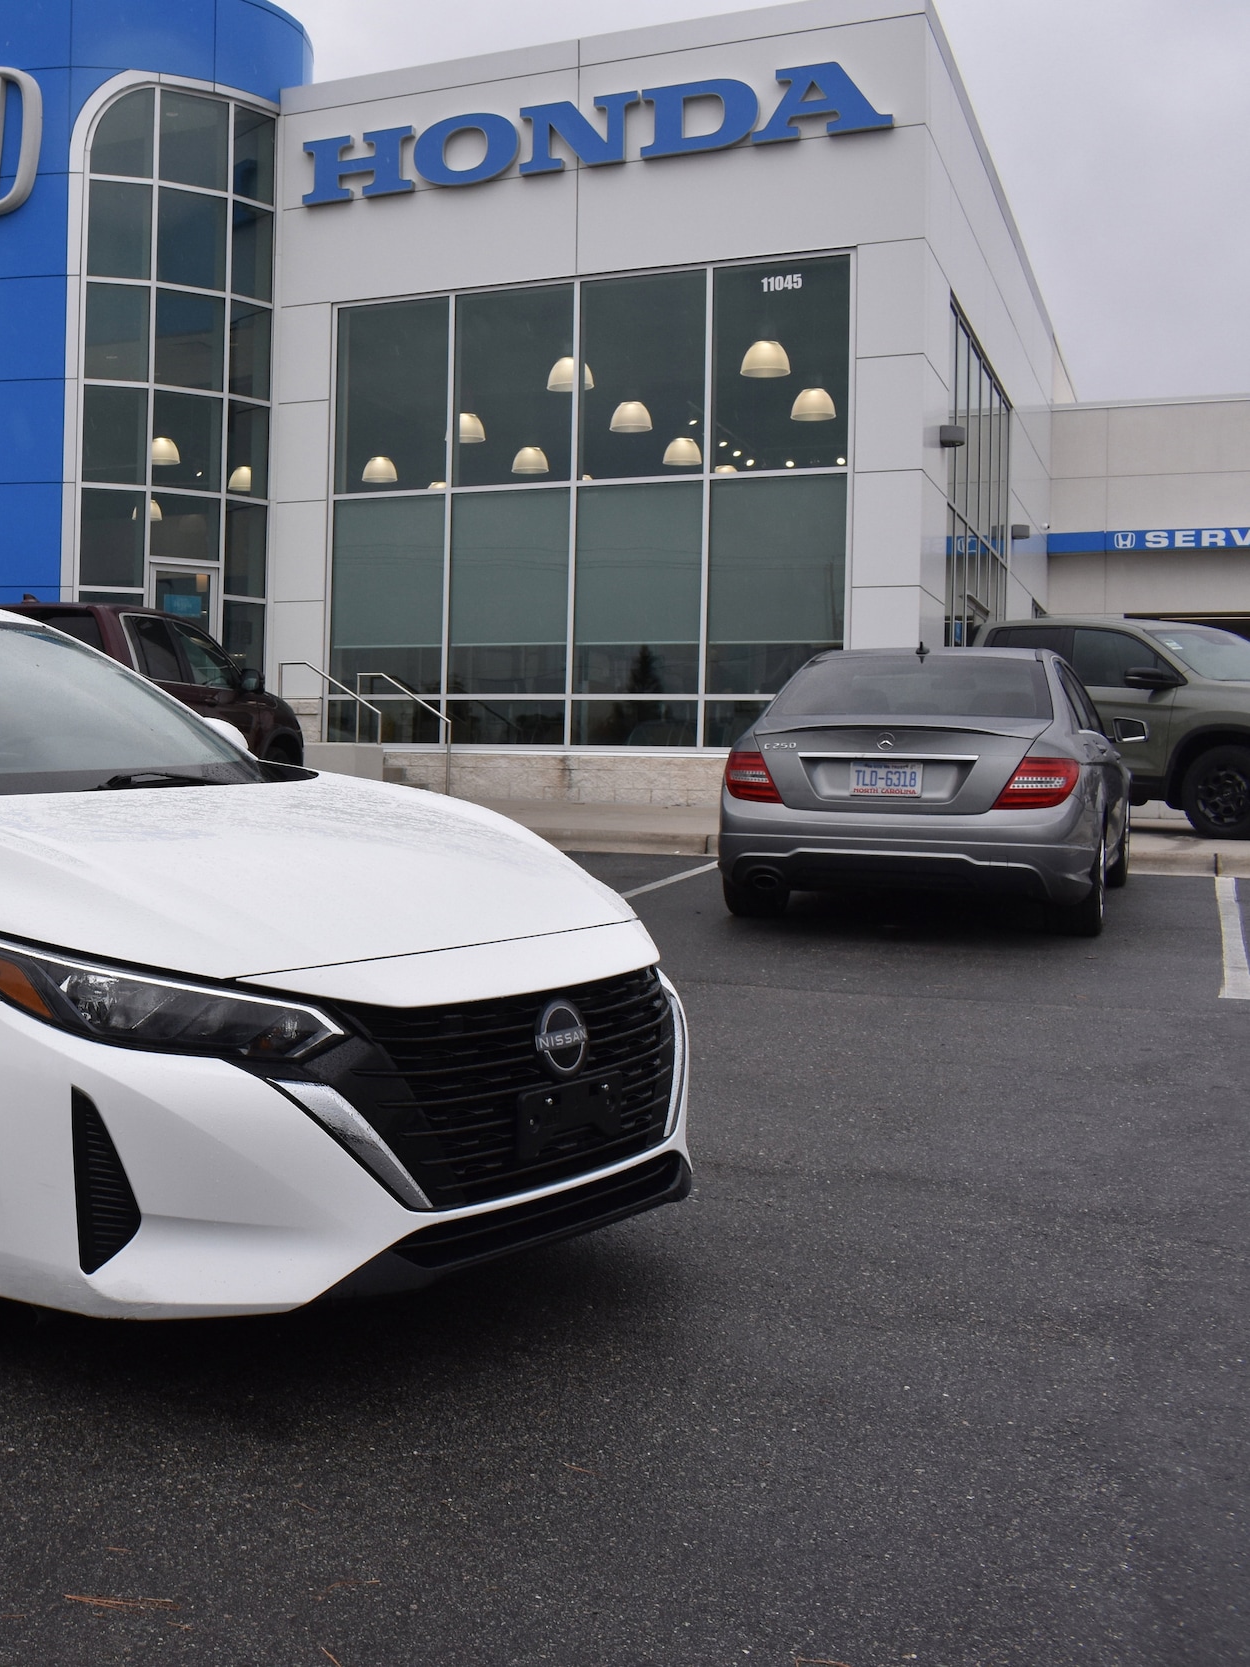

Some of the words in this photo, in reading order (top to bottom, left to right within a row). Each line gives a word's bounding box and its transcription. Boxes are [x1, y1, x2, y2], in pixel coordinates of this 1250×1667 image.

[302, 61, 894, 206] HONDA
[761, 274, 803, 292] 11045
[1144, 529, 1250, 548] SERV
[855, 770, 917, 788] TLD-6318
[538, 1028, 588, 1049] NISSAN
